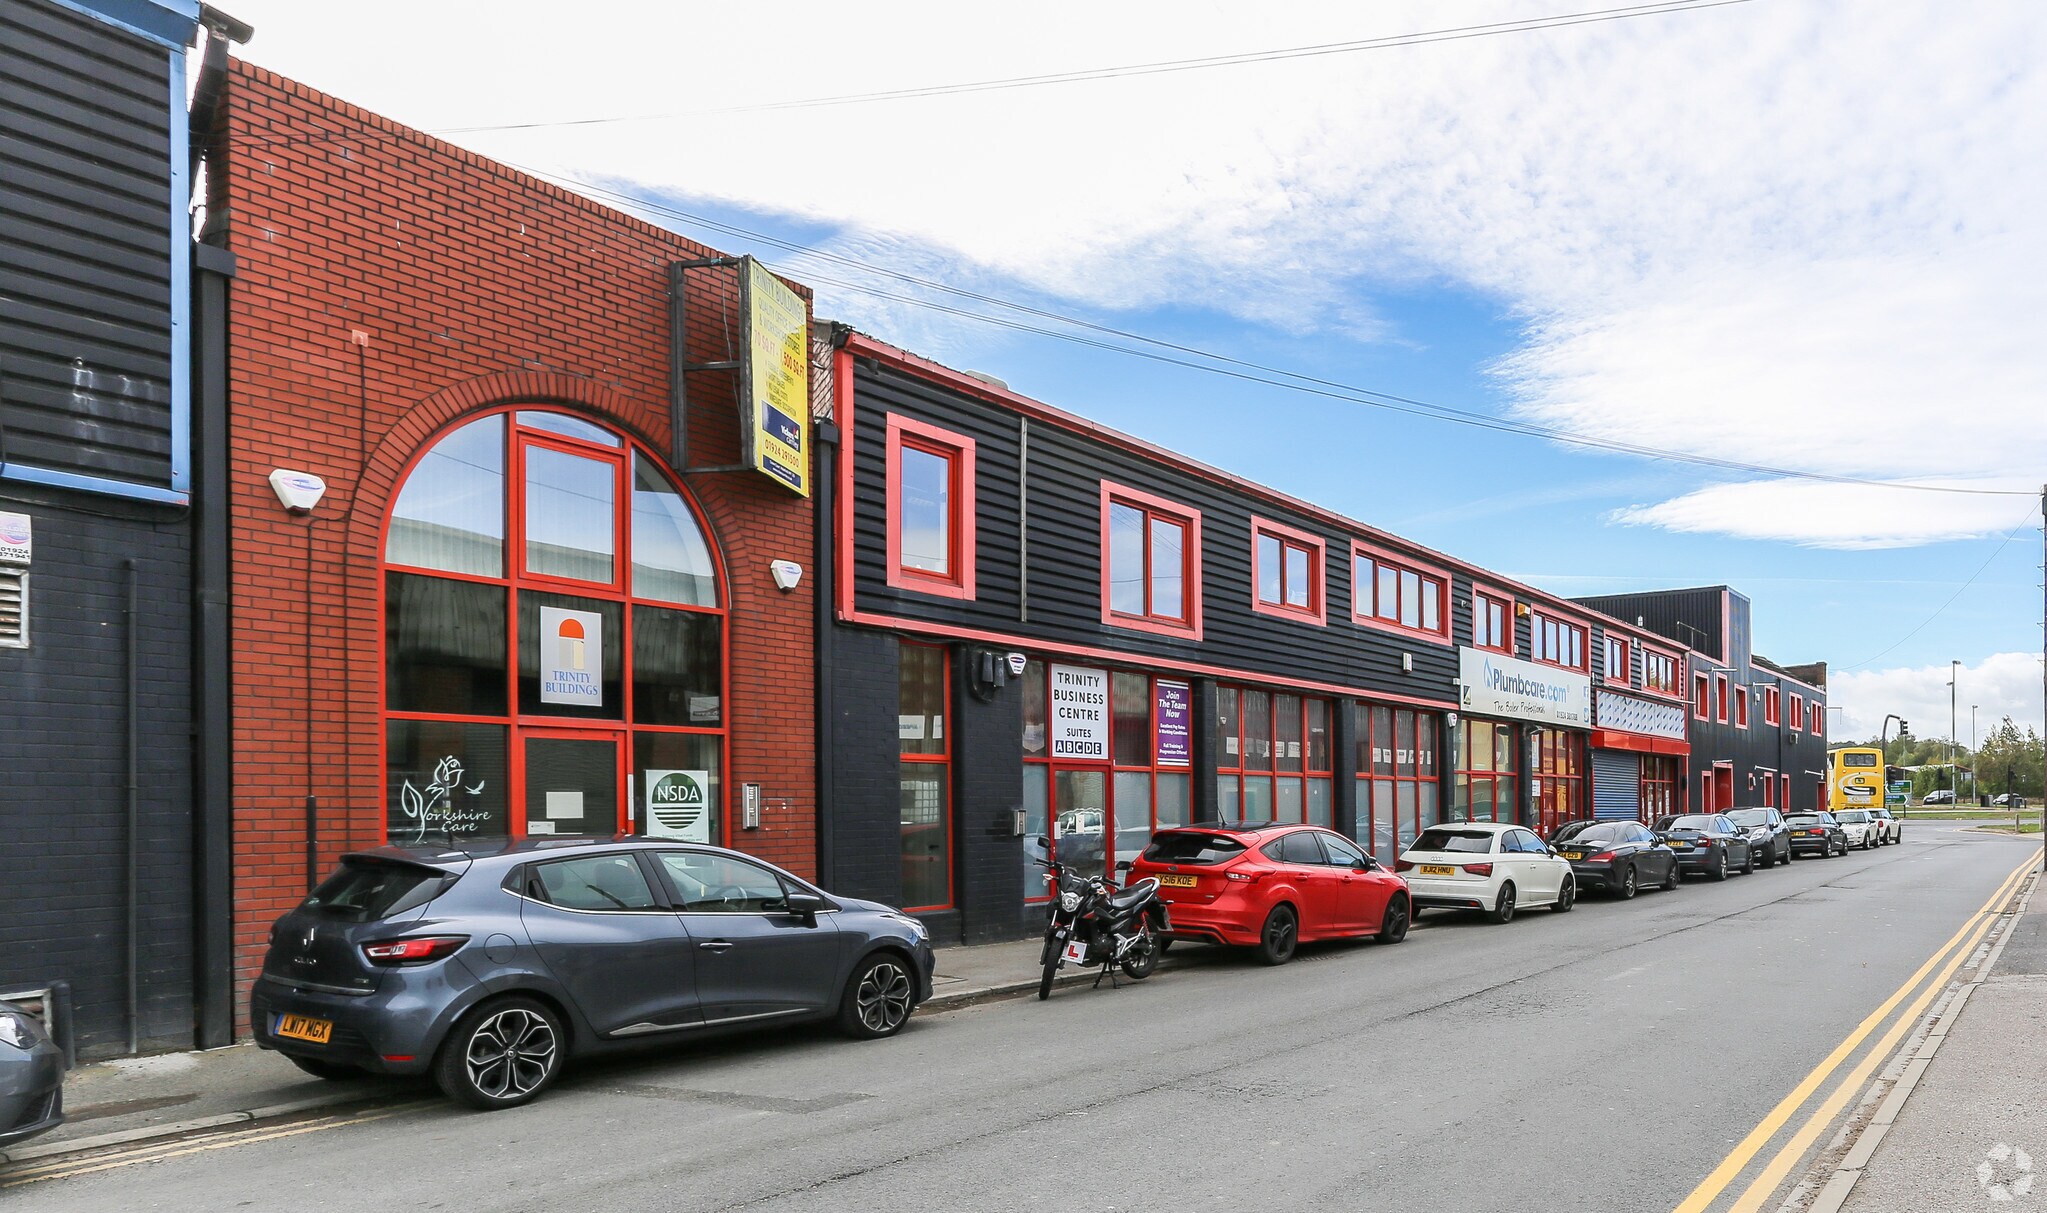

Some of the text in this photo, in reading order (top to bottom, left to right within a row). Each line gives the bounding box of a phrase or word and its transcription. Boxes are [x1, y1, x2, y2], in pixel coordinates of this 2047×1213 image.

[752, 264, 804, 324] TRINITY BUILDINGS
[764, 438, 781, 458] 01924
[781, 448, 800, 469] 291500
[0, 546, 29, 555] 01924
[552, 670, 591, 683] TRINITY
[1057, 672, 1100, 688] TRINITY
[545, 681, 598, 696] BUILDINGS
[1166, 690, 1180, 700] Join
[1053, 689, 1104, 705] BUSINESS
[1158, 698, 1187, 710] The Team
[1494, 701, 1504, 712] The
[1058, 707, 1099, 721] CENTRE
[1165, 709, 1180, 719] Now
[1066, 727, 1092, 738] SUITES
[657, 785, 700, 801] NSDA
[441, 820, 478, 833] Care
[1159, 874, 1193, 886] YS16 KOE
[1067, 944, 1079, 958] L
[282, 1015, 329, 1039] LW17 MGX
